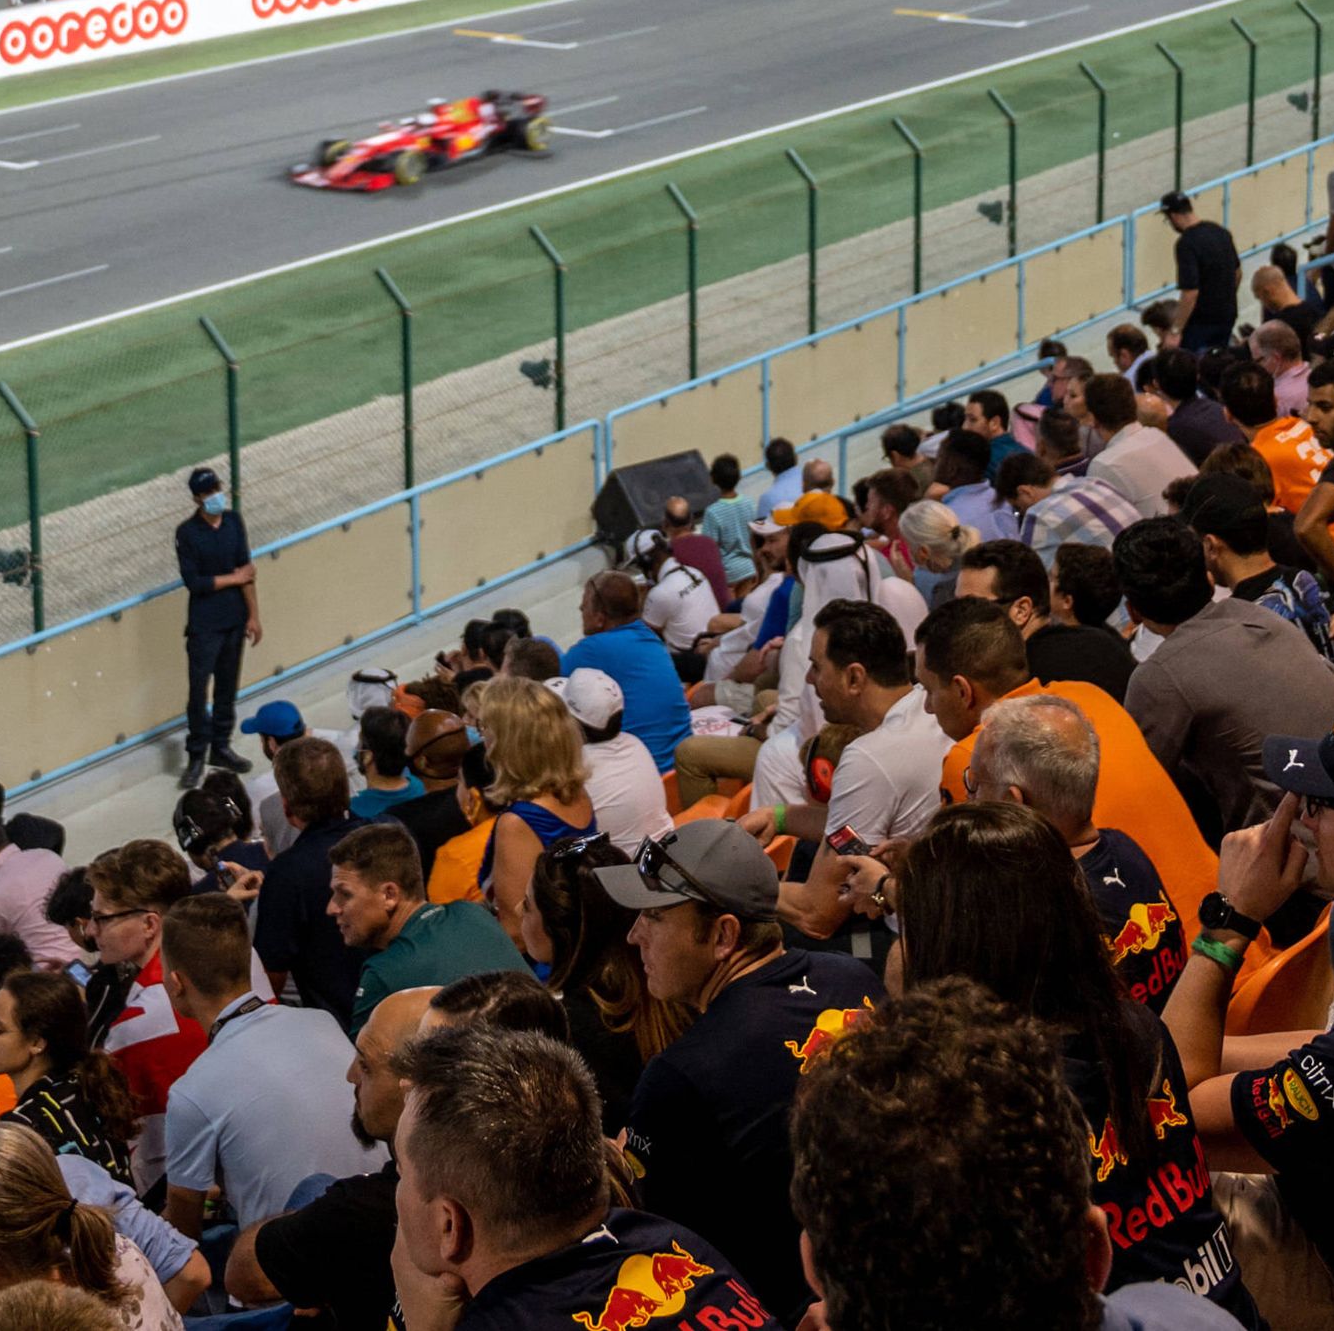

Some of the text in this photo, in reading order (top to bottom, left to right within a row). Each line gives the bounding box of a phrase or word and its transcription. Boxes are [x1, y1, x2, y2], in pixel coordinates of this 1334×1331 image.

[1130, 955, 1163, 1005] ed
[1288, 1080, 1314, 1115] RAUCH
[1100, 1176, 1175, 1250] Red
